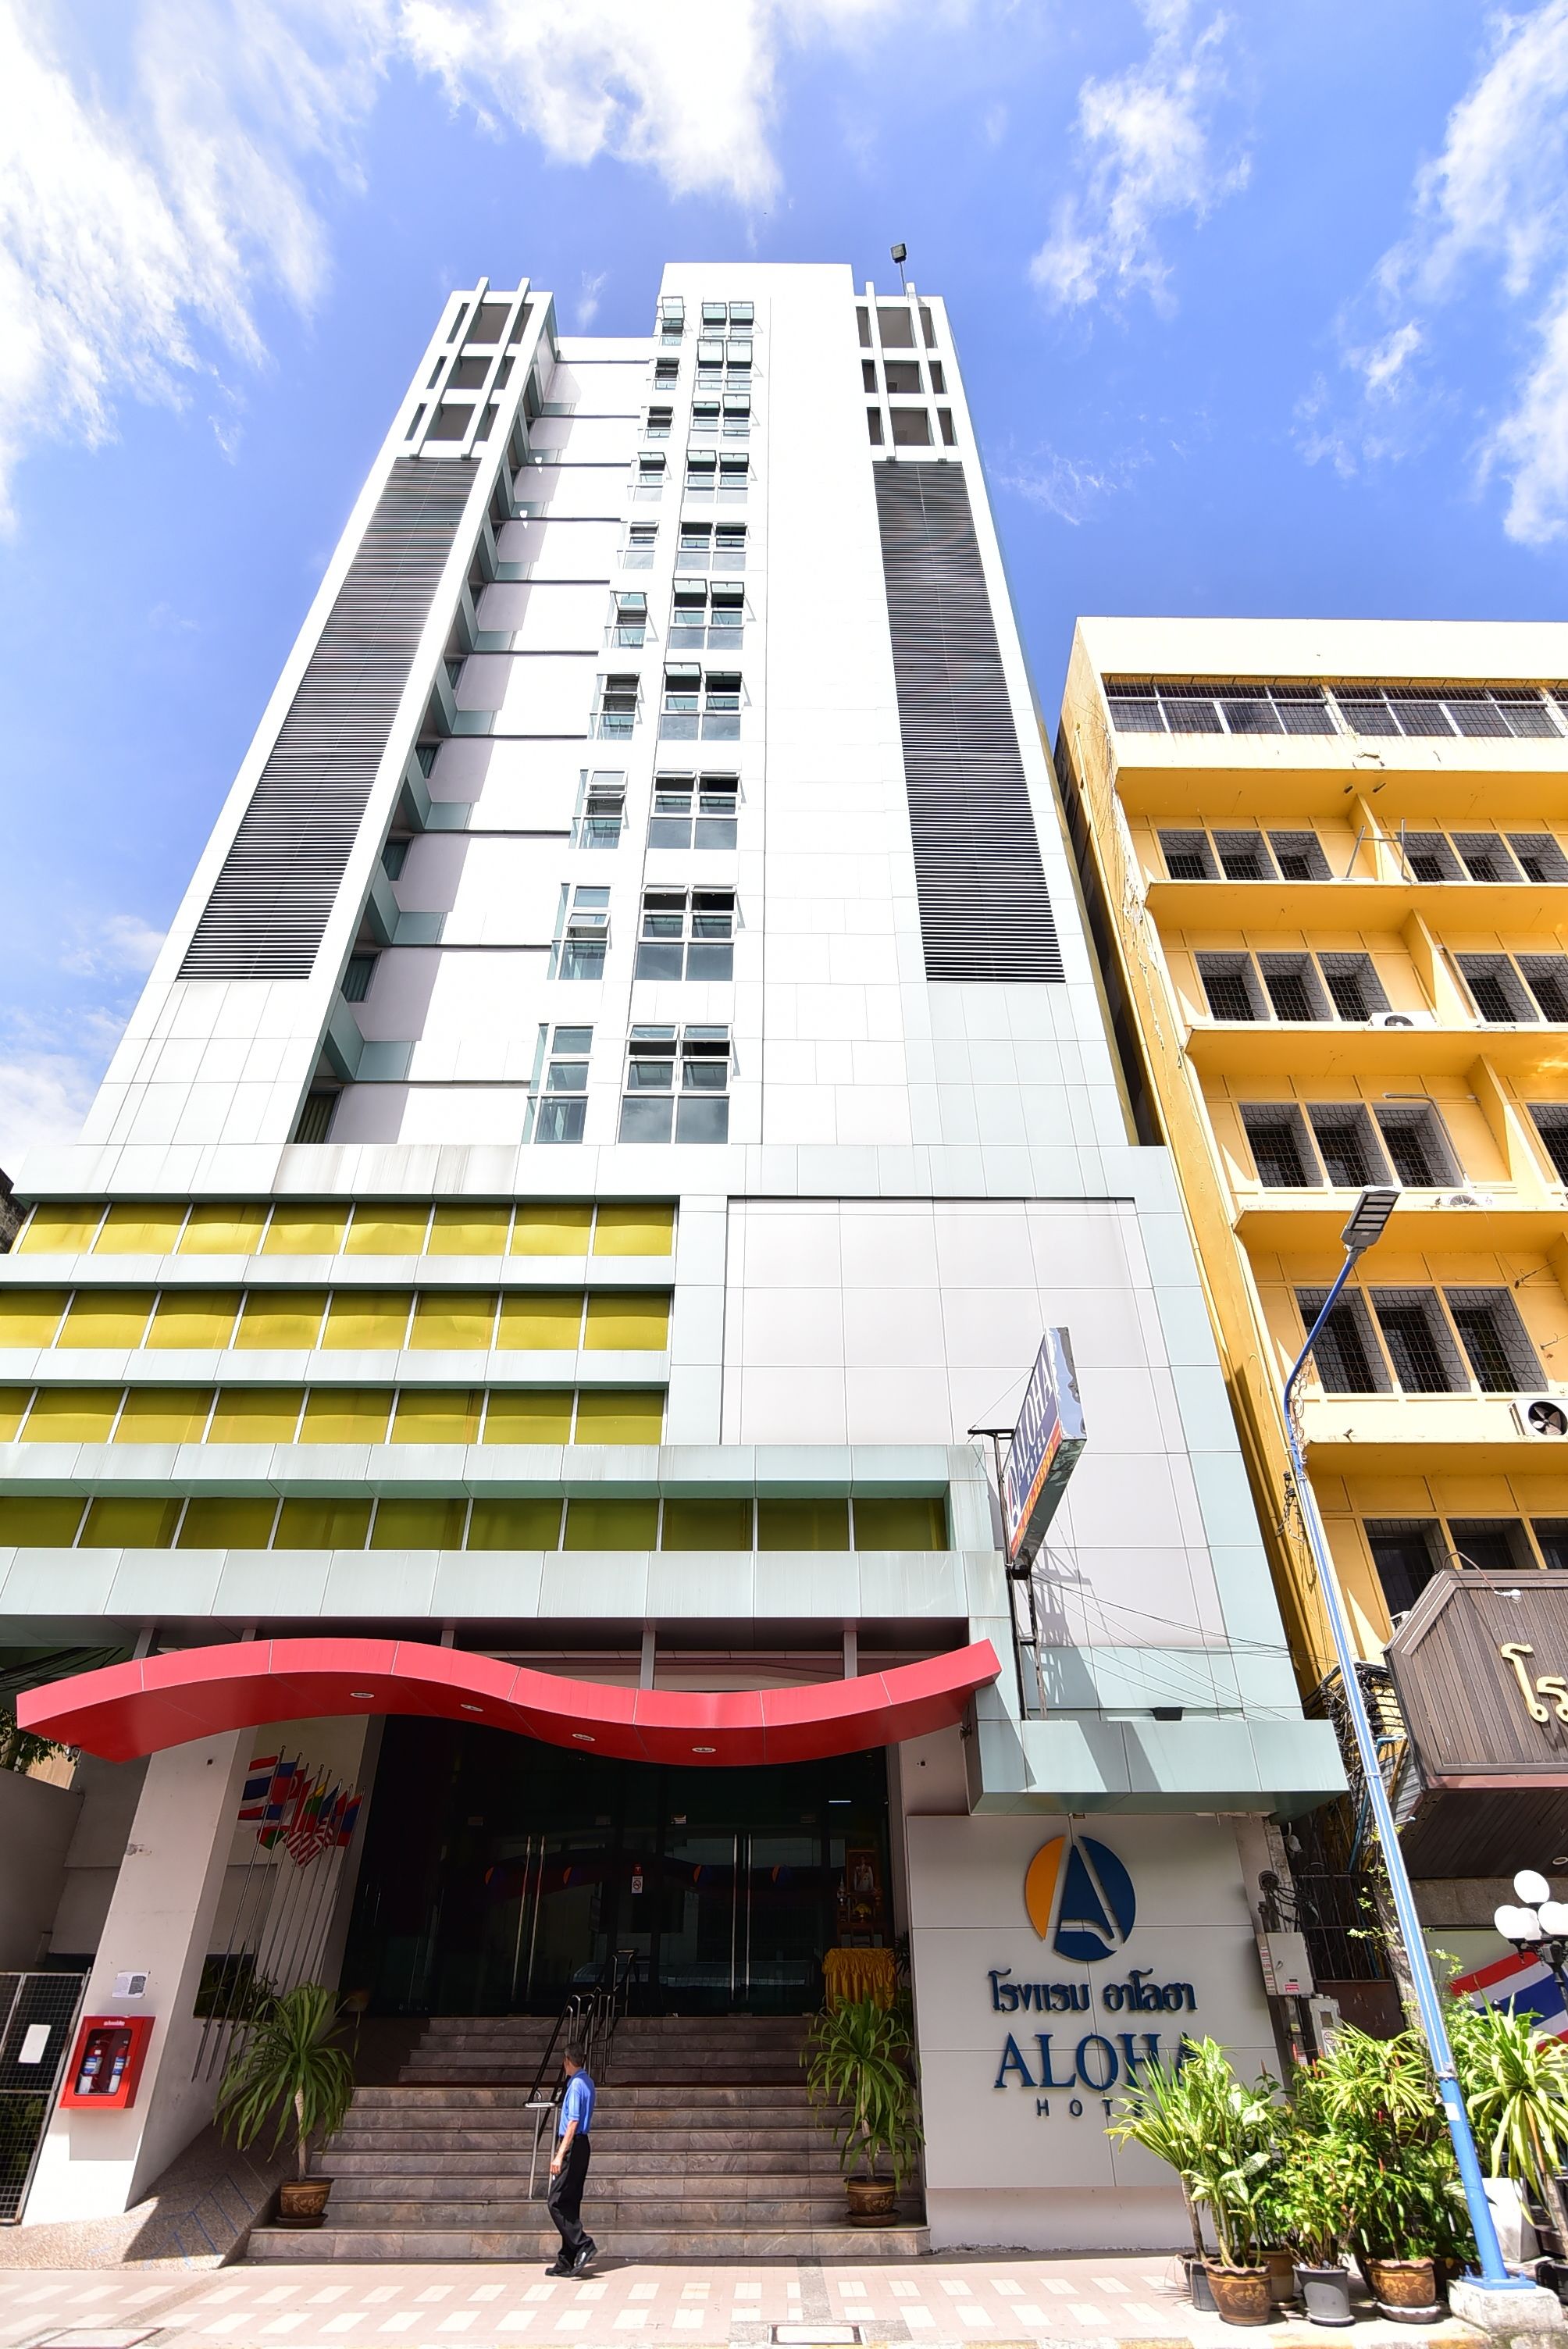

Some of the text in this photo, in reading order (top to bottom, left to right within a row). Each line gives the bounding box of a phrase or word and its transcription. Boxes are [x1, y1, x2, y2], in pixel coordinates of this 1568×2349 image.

[1015, 1350, 1053, 1486] ALOHA
[1026, 1428, 1046, 1485] HOTEL
[988, 1968, 1199, 2012] โรงแรม อาโลฮา
